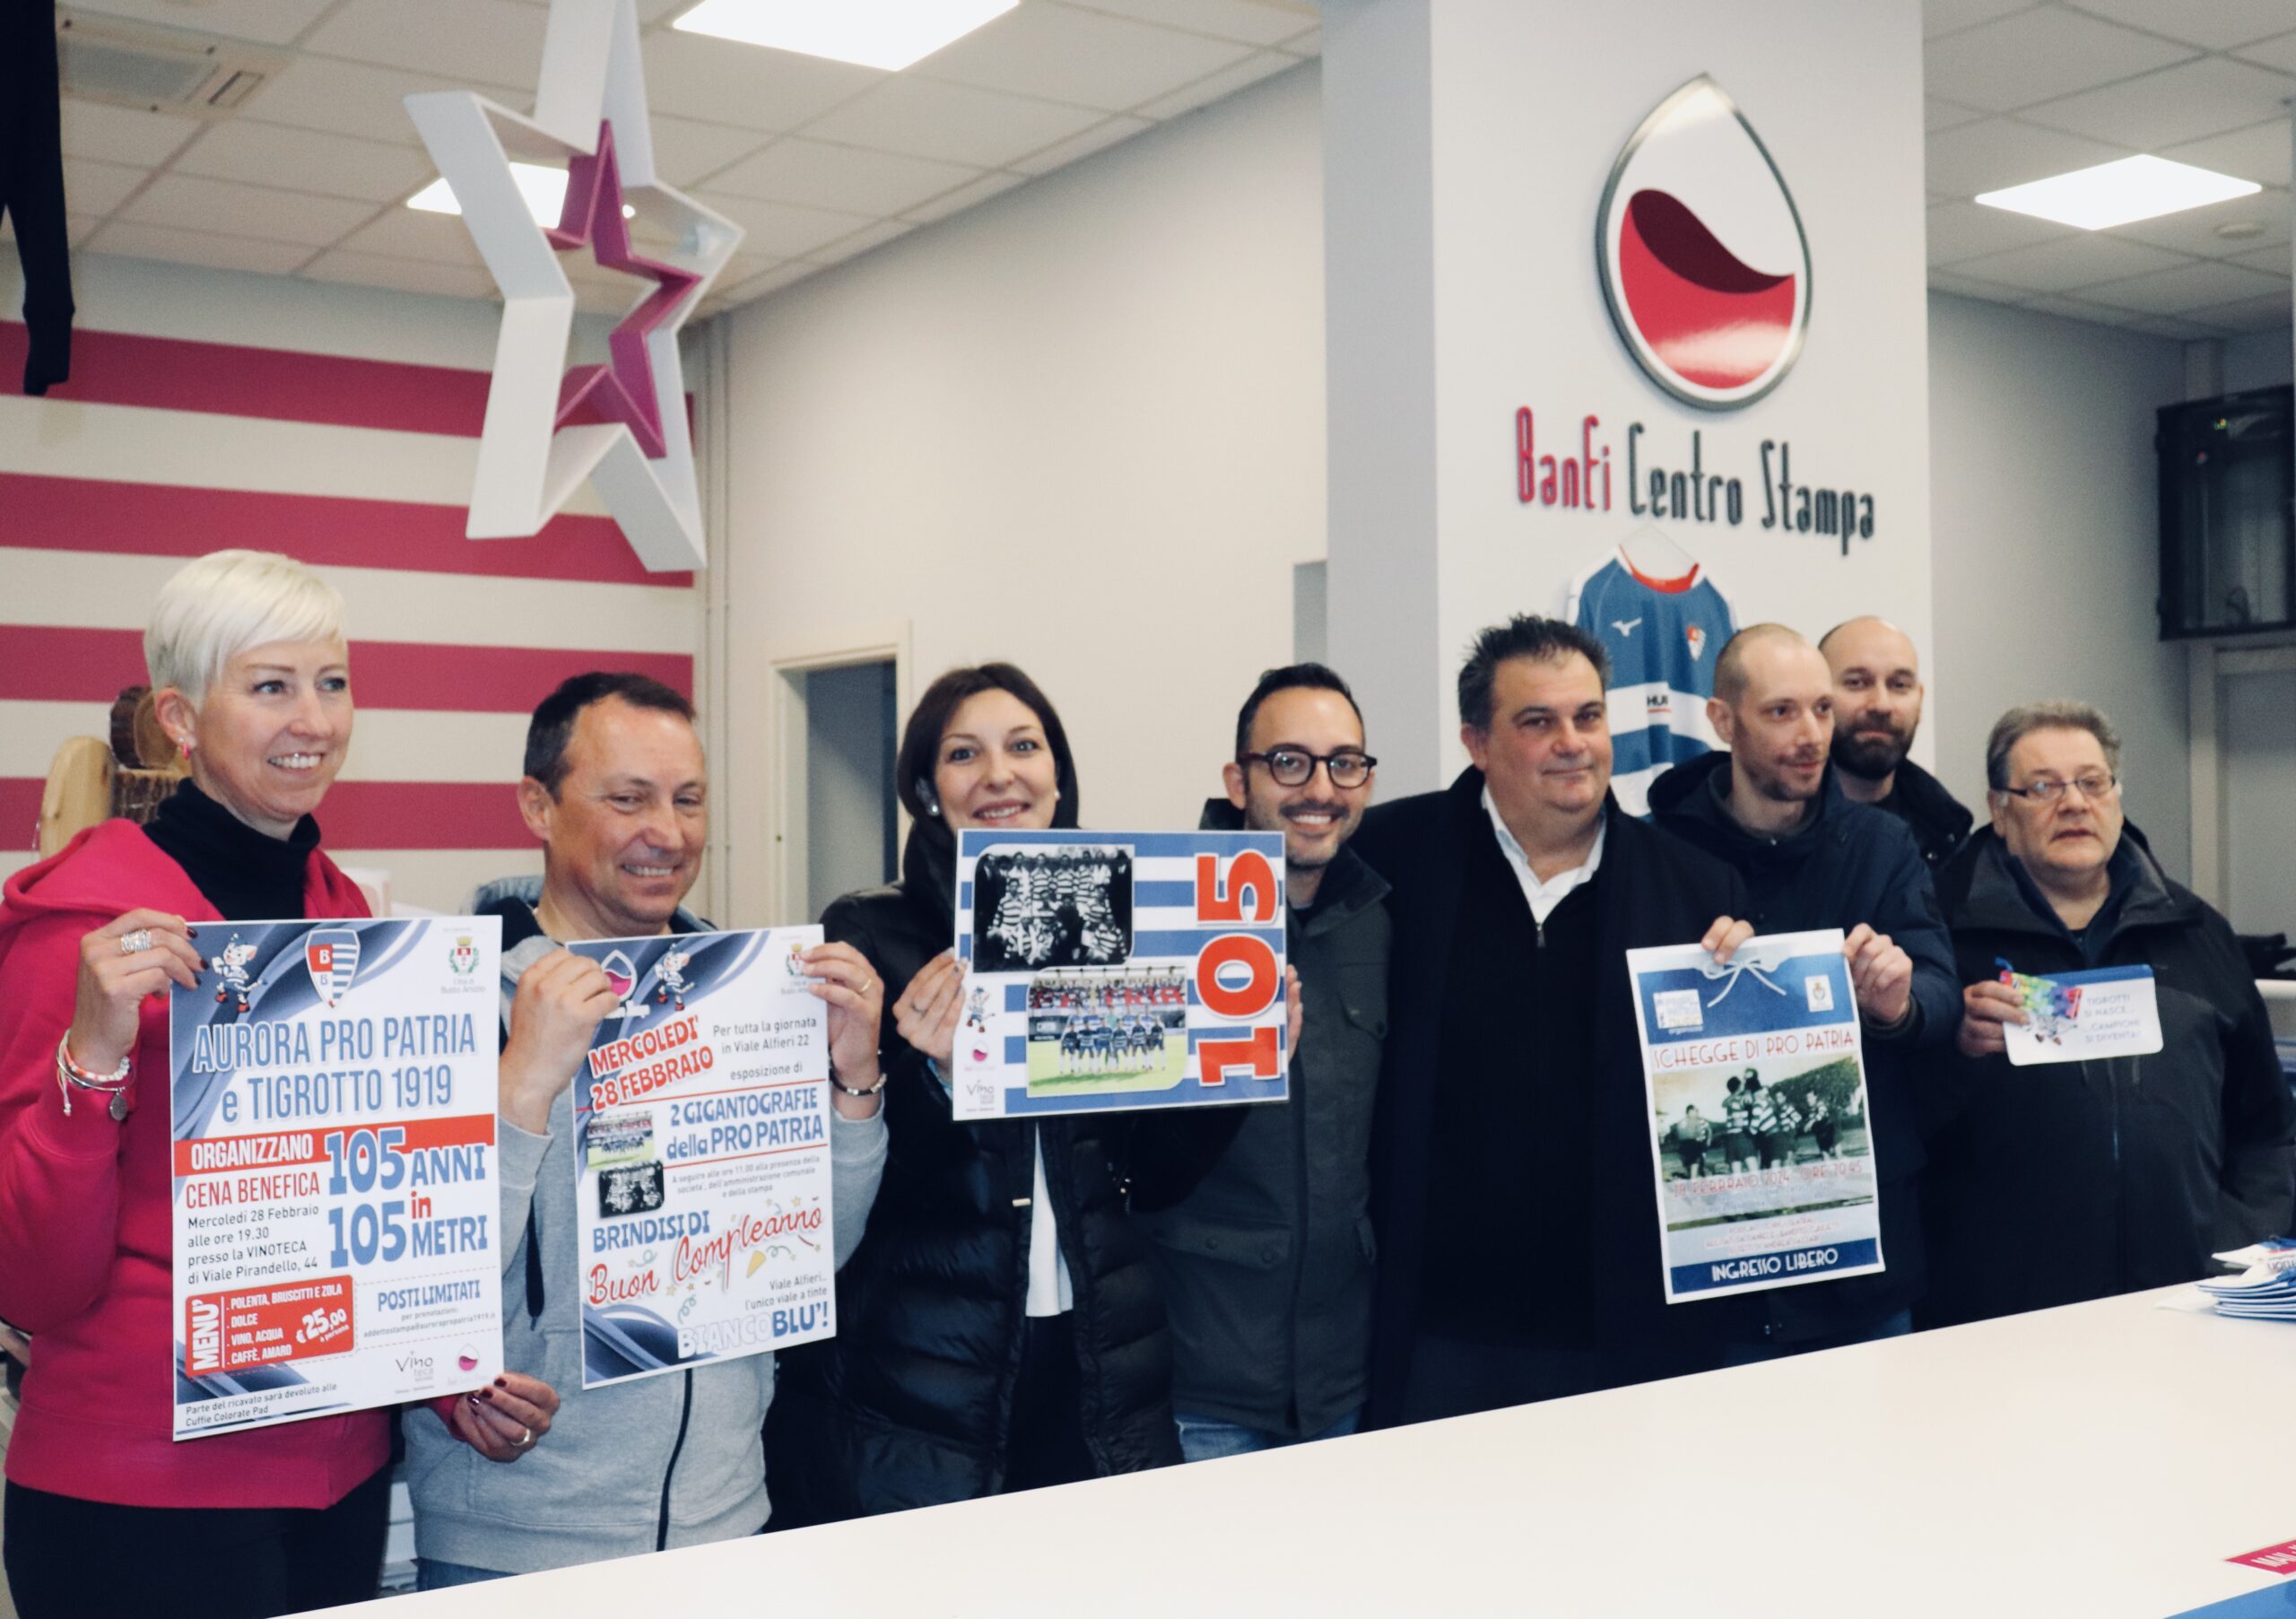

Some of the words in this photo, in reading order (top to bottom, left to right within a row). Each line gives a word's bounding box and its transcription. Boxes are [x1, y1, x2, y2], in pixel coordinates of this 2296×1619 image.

[1516, 405, 1611, 511] Banfi
[1628, 422, 1743, 527] Centro
[1761, 439, 1874, 556] Stampa
[1196, 849, 1279, 1085] 105
[713, 1024, 732, 1037] Per
[734, 1022, 760, 1035] tutta
[761, 1021, 772, 1032] la
[772, 1017, 818, 1033] giornata
[193, 1021, 311, 1075] AURORA
[320, 1018, 373, 1063] PRO
[383, 1014, 476, 1058] PATRIA
[590, 1014, 699, 1075] MERCOLEDI'
[721, 1043, 732, 1054] in
[734, 1040, 761, 1053] Viale
[762, 1037, 796, 1049] Alfieri
[797, 1035, 810, 1048] 22
[1654, 1040, 1741, 1070] SCHEGGE
[1745, 1038, 1760, 1059] DI
[1767, 1034, 1799, 1058] PRO
[1805, 1029, 1855, 1053] PATRIA
[591, 1083, 620, 1111] 28
[619, 1046, 715, 1100] FEBBRAIO
[730, 1063, 792, 1083] esposizione
[793, 1061, 804, 1074] di
[222, 1089, 238, 1123] e
[248, 1069, 383, 1121] TIGROTTO
[391, 1065, 453, 1109] 1919
[670, 1104, 681, 1127] 2
[683, 1087, 818, 1125] GIGANTOGRAFIE
[191, 1134, 314, 1171] ORGANIZZANO
[666, 1134, 709, 1161] della
[710, 1123, 753, 1153] PRO
[755, 1114, 824, 1148] PATRIA
[326, 1127, 405, 1197] 105
[411, 1145, 485, 1187] ANNI
[678, 1171, 705, 1187] seguire
[707, 1169, 720, 1180] alle
[722, 1168, 734, 1177] ore
[735, 1163, 754, 1175] 11.00
[755, 1162, 770, 1171] alla
[770, 1158, 801, 1171] presenza
[802, 1154, 821, 1166] della
[782, 1166, 816, 1180] comunale
[186, 1179, 232, 1209] CENA
[238, 1171, 320, 1203] BENEFICA
[411, 1190, 431, 1219] in
[727, 1188, 746, 1198] della
[747, 1184, 774, 1197] stampa
[250, 1209, 265, 1223] 28
[268, 1203, 319, 1221] Febbraio
[187, 1235, 211, 1248] alle
[213, 1232, 234, 1243] ore
[239, 1226, 269, 1242] 19.30
[328, 1200, 406, 1268] 105
[412, 1214, 488, 1258] METRI
[593, 1215, 684, 1253] BRINDISI
[688, 1211, 710, 1237] DI
[187, 1251, 229, 1269] presso
[232, 1249, 244, 1261] la
[247, 1240, 307, 1258] VINOTECA
[675, 1207, 823, 1291] Compleanno
[1711, 1258, 1781, 1282] INGRESSO
[1786, 1247, 1839, 1271] LIBERO
[187, 1272, 199, 1284] di
[202, 1266, 232, 1282] Viale
[236, 1259, 301, 1279] Pirandello,
[304, 1257, 318, 1269] 44
[589, 1263, 660, 1305] Buon
[769, 1279, 792, 1291] Viale
[230, 1293, 271, 1310] POLENTA,
[271, 1287, 314, 1304] BRUSCITTI
[314, 1286, 321, 1299] E
[321, 1284, 344, 1297] ZOLA
[378, 1288, 421, 1312] POSTI
[422, 1280, 482, 1306] LIMITATI
[744, 1296, 775, 1310] l'unico
[777, 1292, 798, 1304] viale
[799, 1292, 806, 1300] a
[807, 1286, 828, 1299] tinte
[230, 1312, 259, 1328] DOLCE
[401, 1313, 414, 1323] per
[255, 1327, 284, 1343] ACQUA
[262, 1344, 293, 1361] AMARO
[396, 1351, 434, 1372] Vino
[186, 1406, 211, 1415] Parte
[212, 1400, 227, 1411] del
[227, 1394, 263, 1408] ricavato
[264, 1391, 283, 1403] sarà
[284, 1386, 321, 1399] devoluto
[321, 1381, 338, 1392] alle
[186, 1414, 213, 1427] Cuffie
[213, 1408, 251, 1423] Colorate
[252, 1405, 269, 1415] Pad
